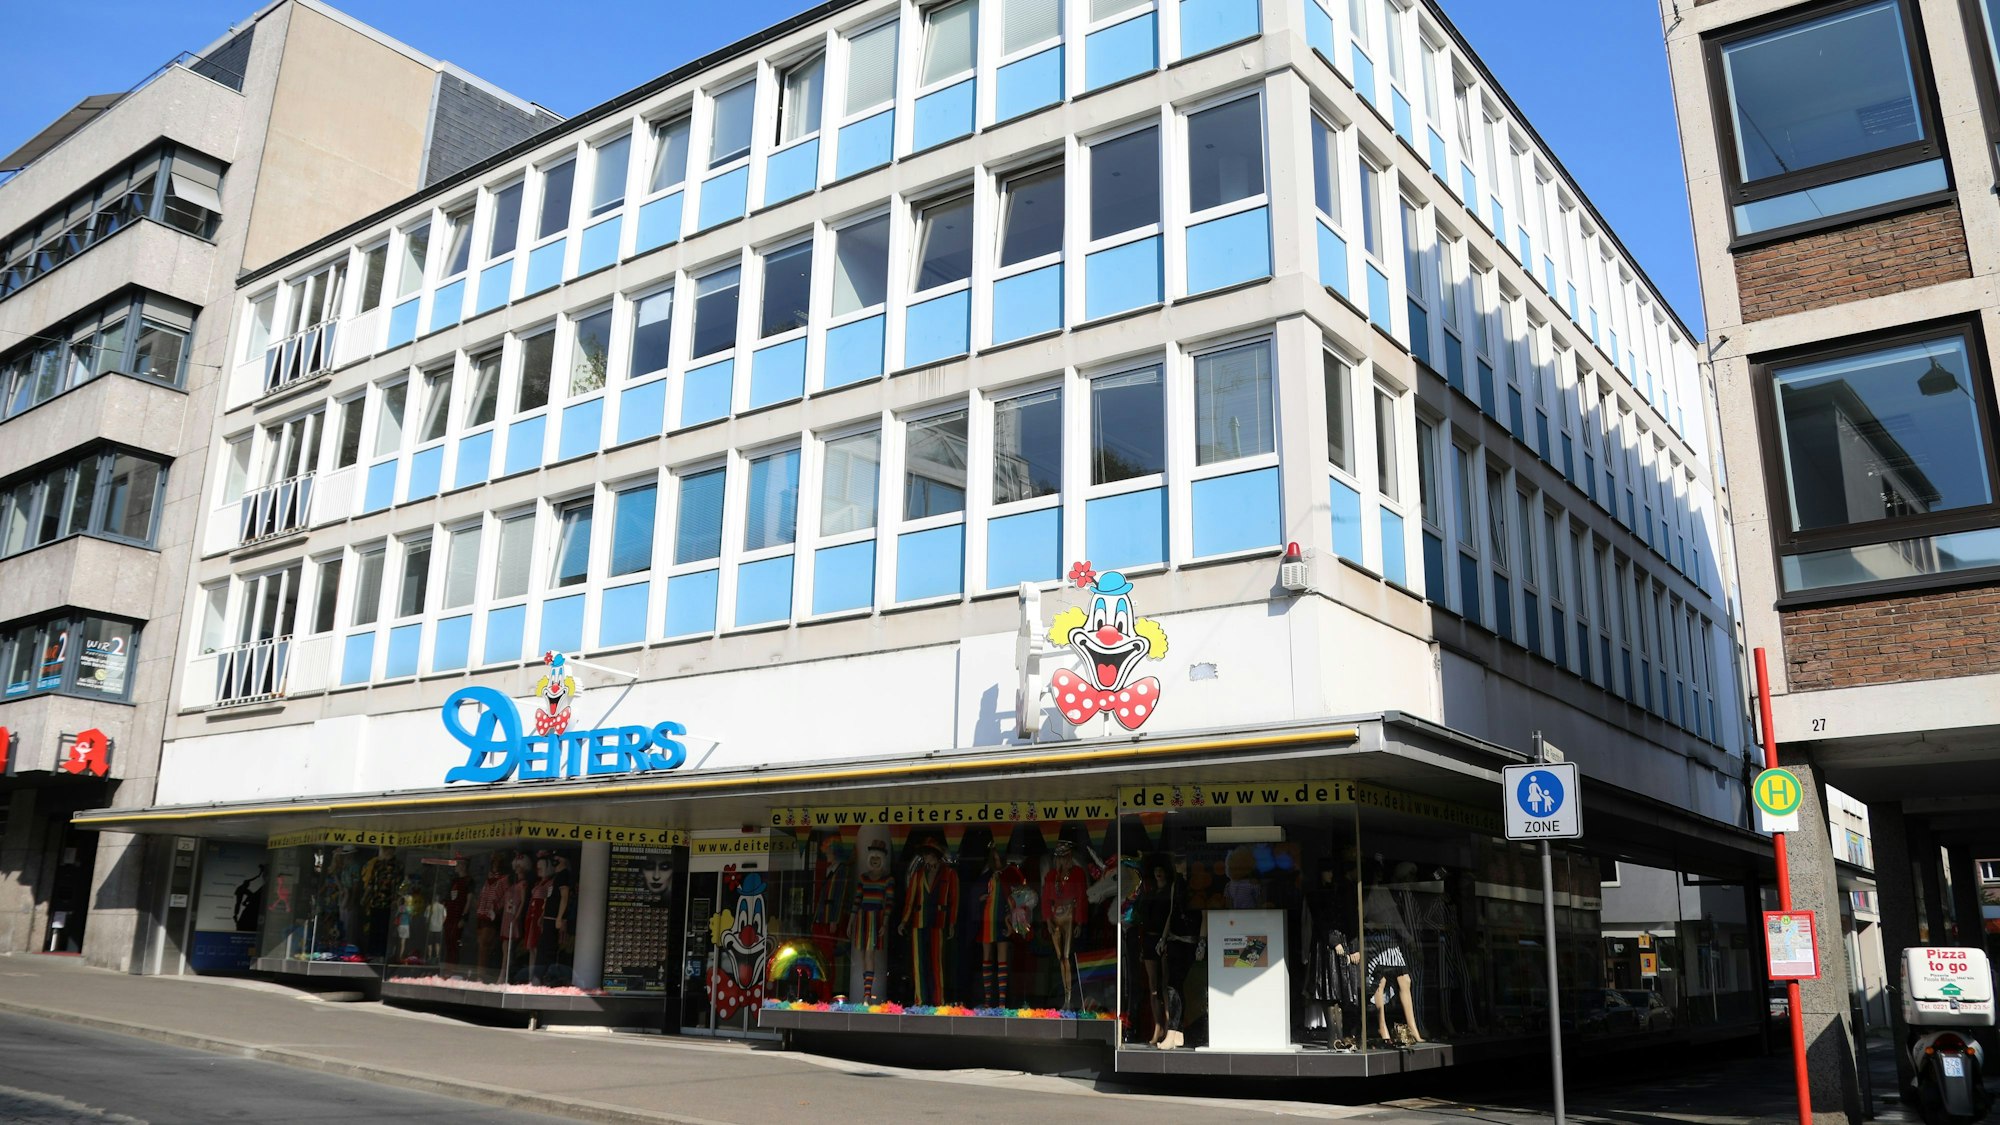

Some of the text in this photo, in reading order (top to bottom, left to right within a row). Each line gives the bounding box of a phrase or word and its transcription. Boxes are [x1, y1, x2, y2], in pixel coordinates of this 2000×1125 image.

[86, 636, 124, 656] WIR 2
[1812, 718, 1827, 732] 27
[1767, 779, 1789, 806] H
[816, 804, 1004, 824] www.deiters.de
[1524, 820, 1560, 833] ZONE
[1926, 949, 1967, 959] Pizza
[1928, 960, 1968, 974] to go
